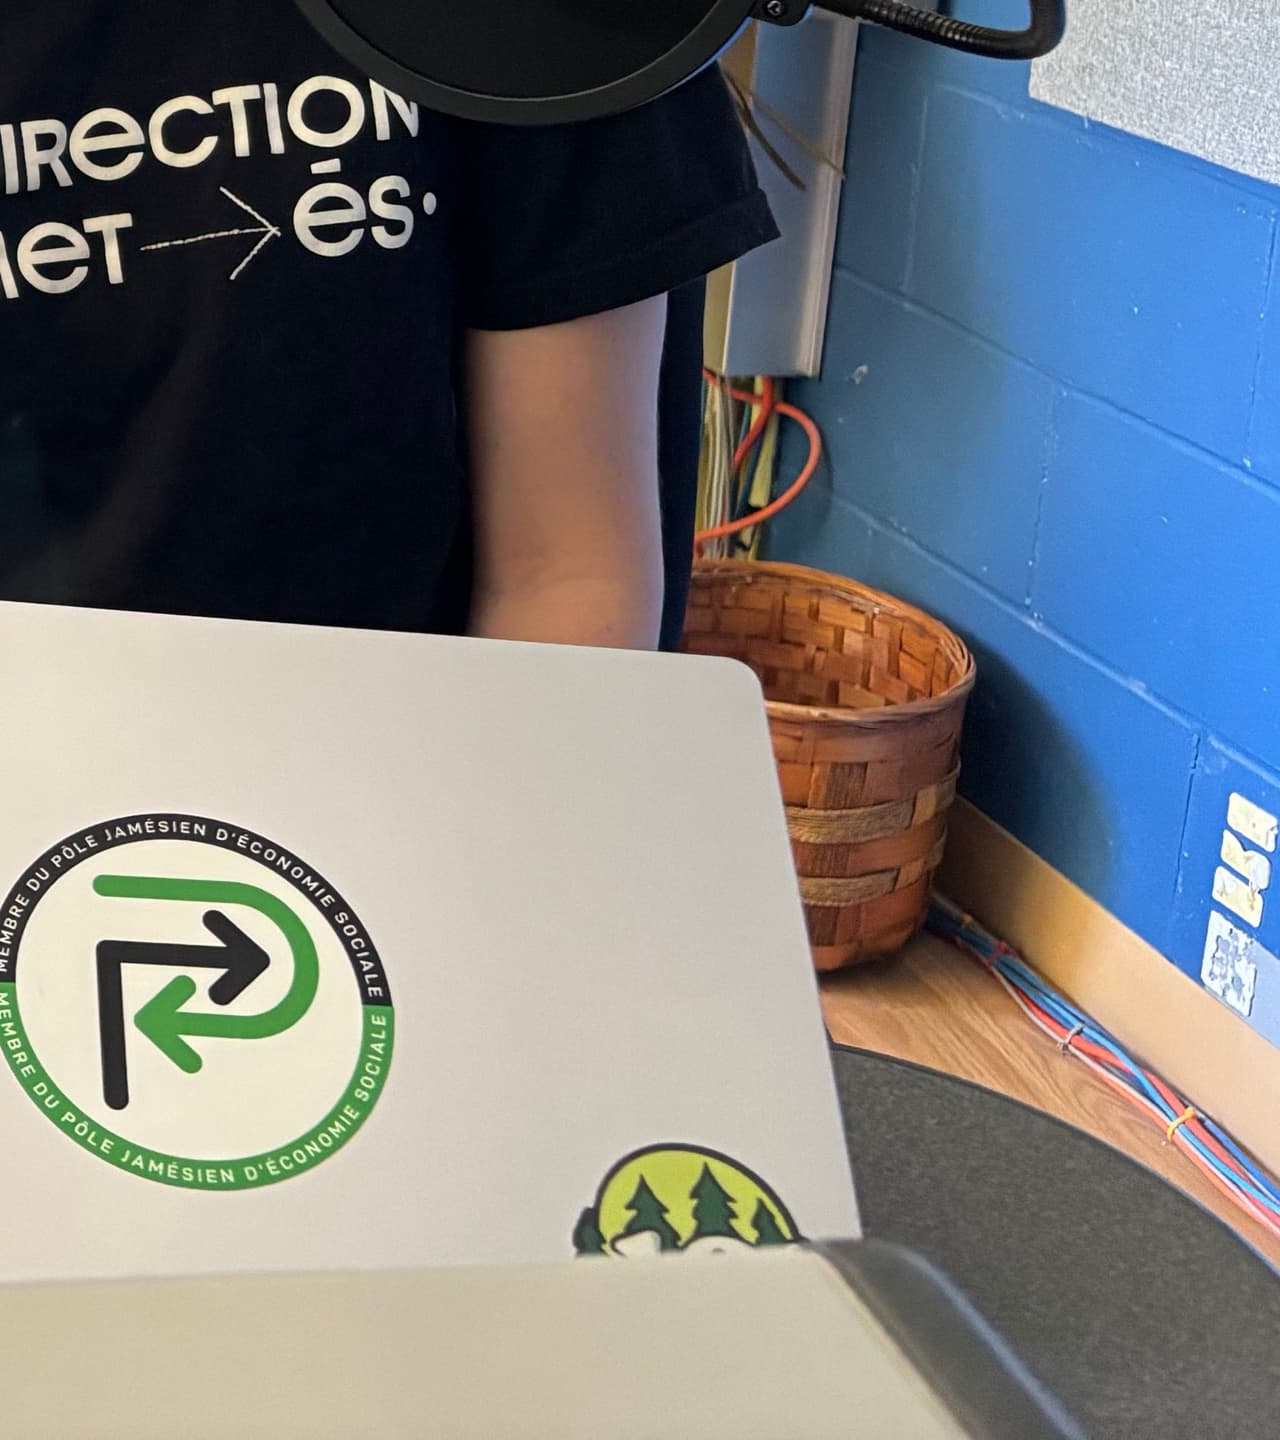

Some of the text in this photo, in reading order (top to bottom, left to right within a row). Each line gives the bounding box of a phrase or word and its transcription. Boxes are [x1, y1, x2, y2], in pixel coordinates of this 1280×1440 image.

[26, 867, 50, 893] DU
[50, 833, 99, 868] PÔLE
[104, 817, 207, 842] JAMÉSIEN
[215, 827, 336, 908] D'ÉCONOMIE
[334, 910, 384, 998] SOCIALE
[32, 1081, 59, 1109] DU
[60, 1110, 115, 1153] PÔLE
[120, 1149, 235, 1184] JAMÉSIEN
[243, 1105, 360, 1183] D'ÉCONOMIE
[354, 1013, 387, 1103] SOCIALE
